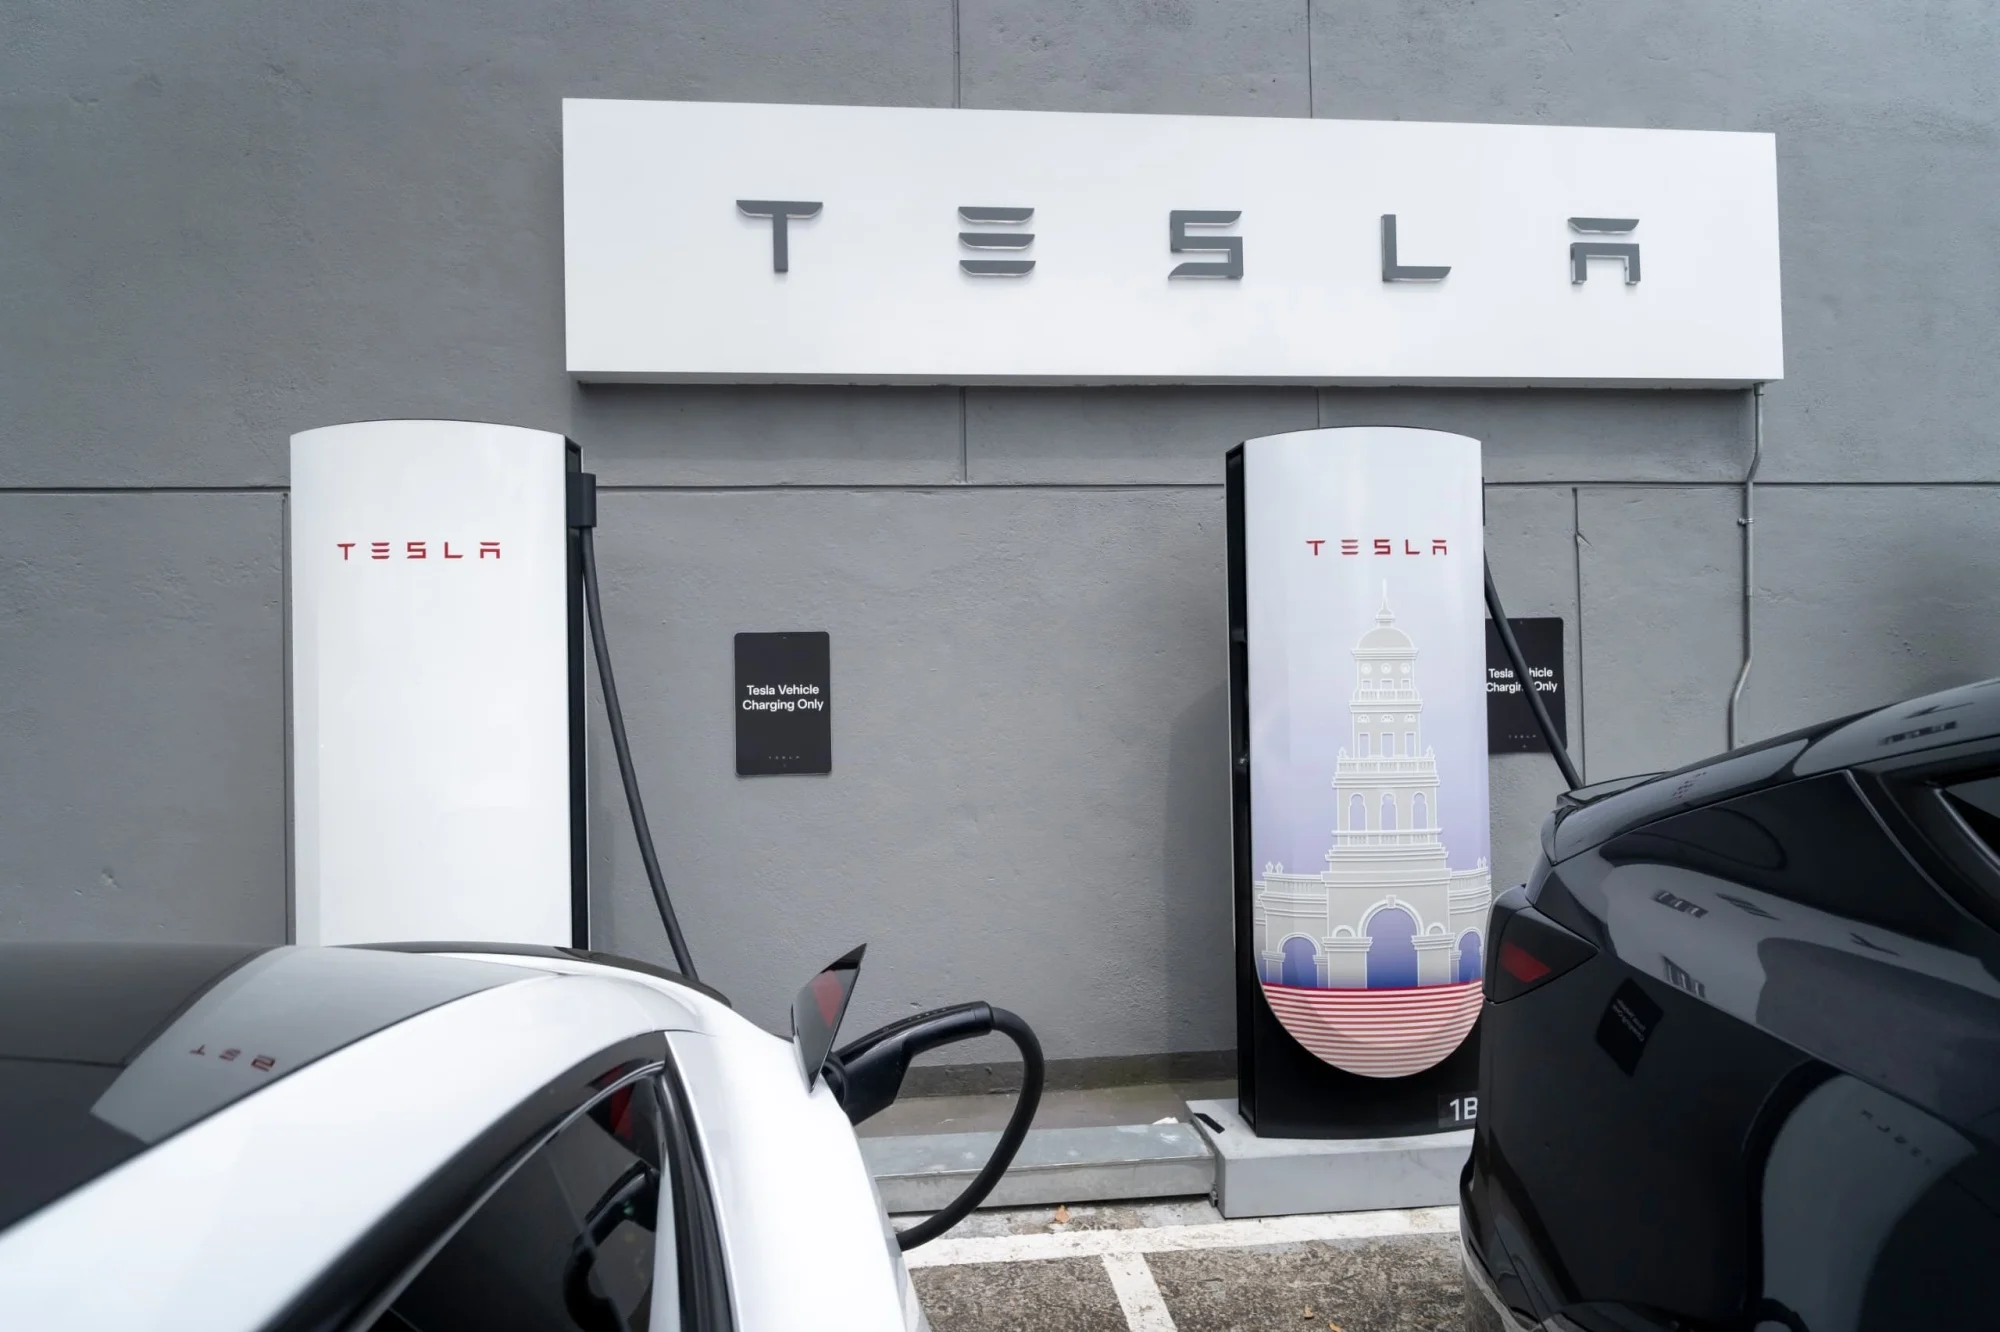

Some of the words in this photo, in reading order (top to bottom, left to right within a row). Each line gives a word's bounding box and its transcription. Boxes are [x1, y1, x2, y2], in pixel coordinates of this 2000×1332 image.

[736, 199, 1641, 285] TESLA
[336, 541, 501, 561] TESLA
[1305, 538, 1448, 556] TESLA
[1488, 668, 1514, 679] Tesla
[1528, 667, 1554, 678] hicle
[746, 684, 776, 696] Tesla
[777, 683, 820, 696] Vehicle
[1486, 681, 1524, 694] Chargi
[1533, 680, 1558, 693] Only
[742, 699, 795, 712] Charging
[797, 698, 824, 711] Only
[1449, 1096, 1479, 1121] 1B
